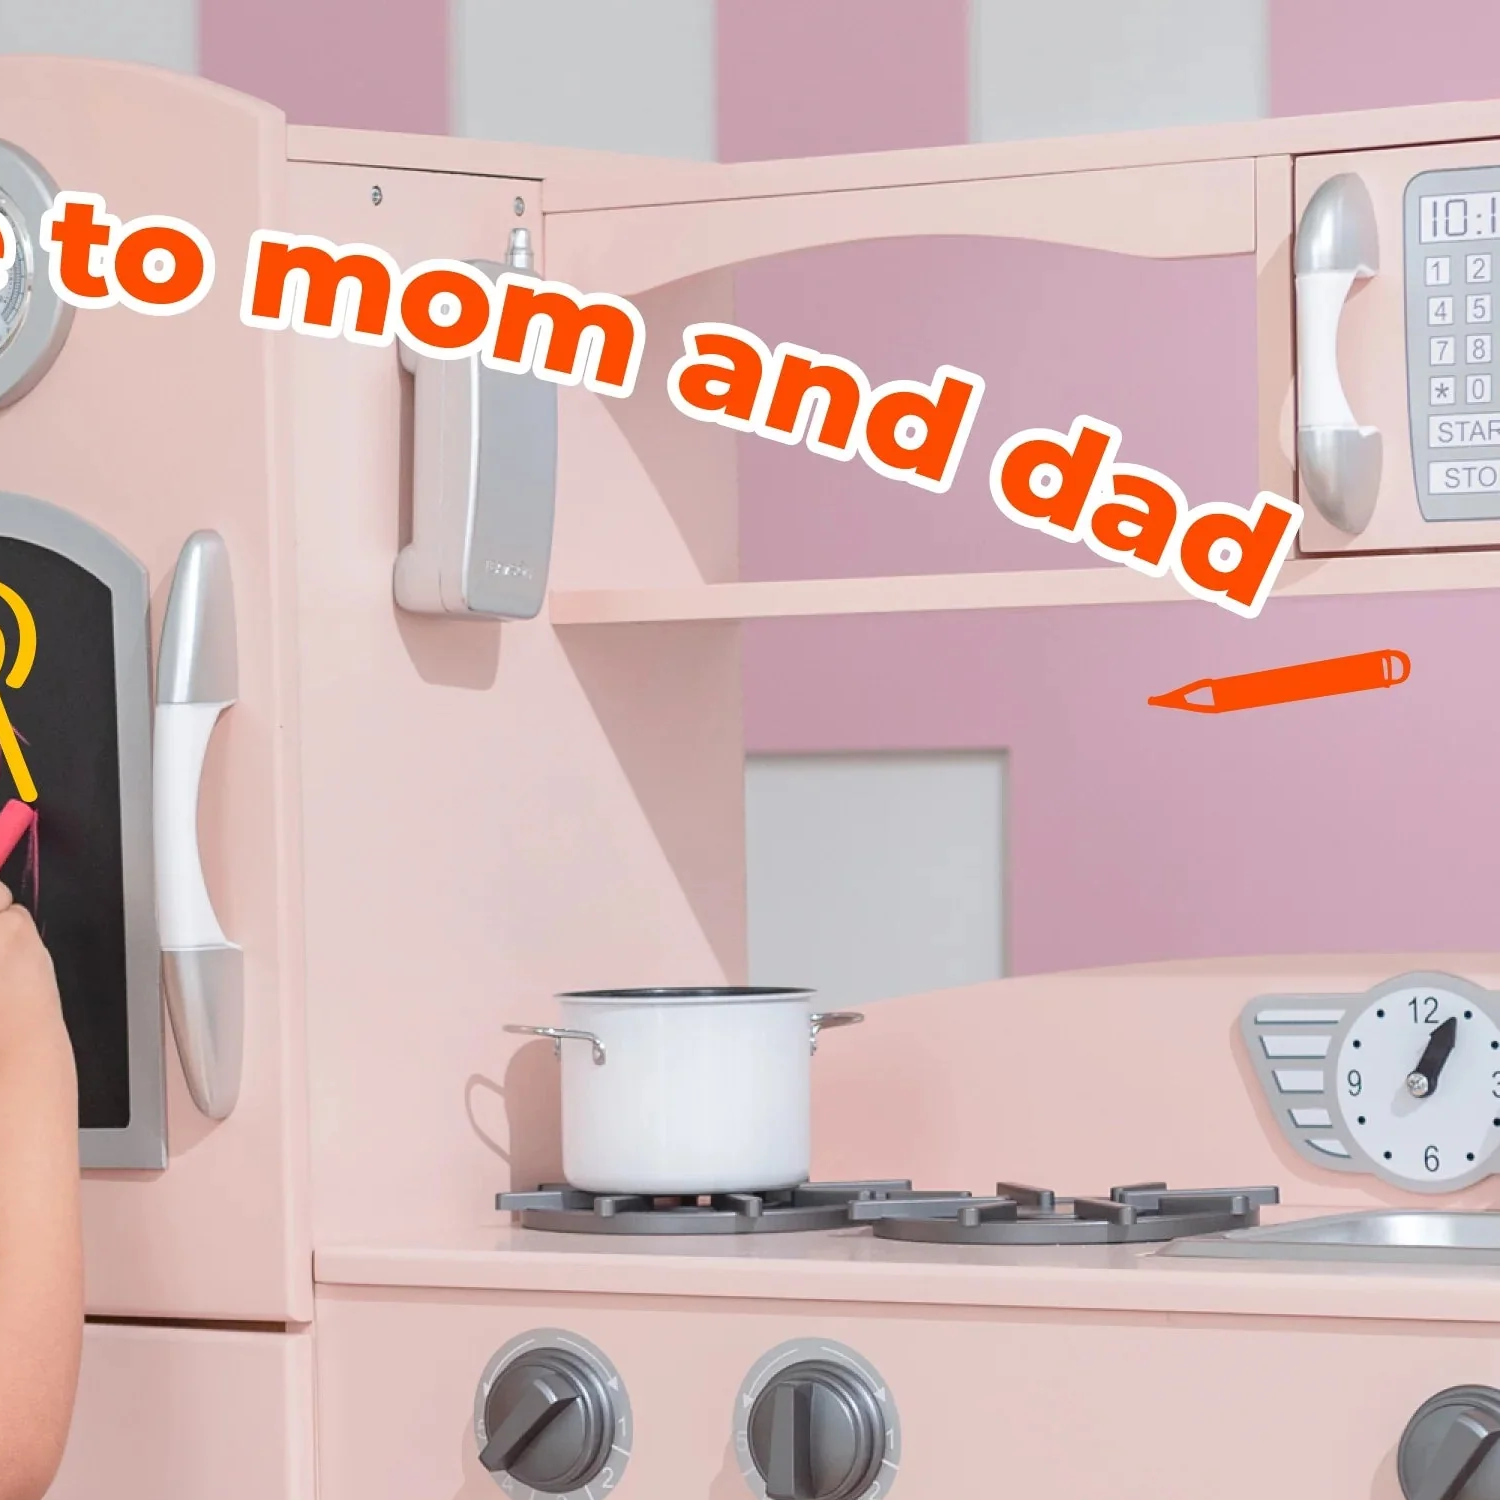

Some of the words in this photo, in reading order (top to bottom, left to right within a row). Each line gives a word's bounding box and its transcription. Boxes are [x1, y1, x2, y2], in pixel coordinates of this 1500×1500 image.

[1431, 260, 1440, 281] 1
[1472, 257, 1485, 279] 2
[1434, 300, 1447, 321] 4
[1472, 298, 1486, 319] 5
[1436, 340, 1449, 361] 7
[1472, 338, 1486, 360] 8
[1472, 378, 1485, 400] 0
[1408, 996, 1440, 1024] 12
[1347, 1069, 1362, 1096] 9
[1424, 1145, 1440, 1172] 6
[886, 1428, 895, 1450] 1
[602, 1467, 614, 1489] 2
[618, 1416, 627, 1437] 1
